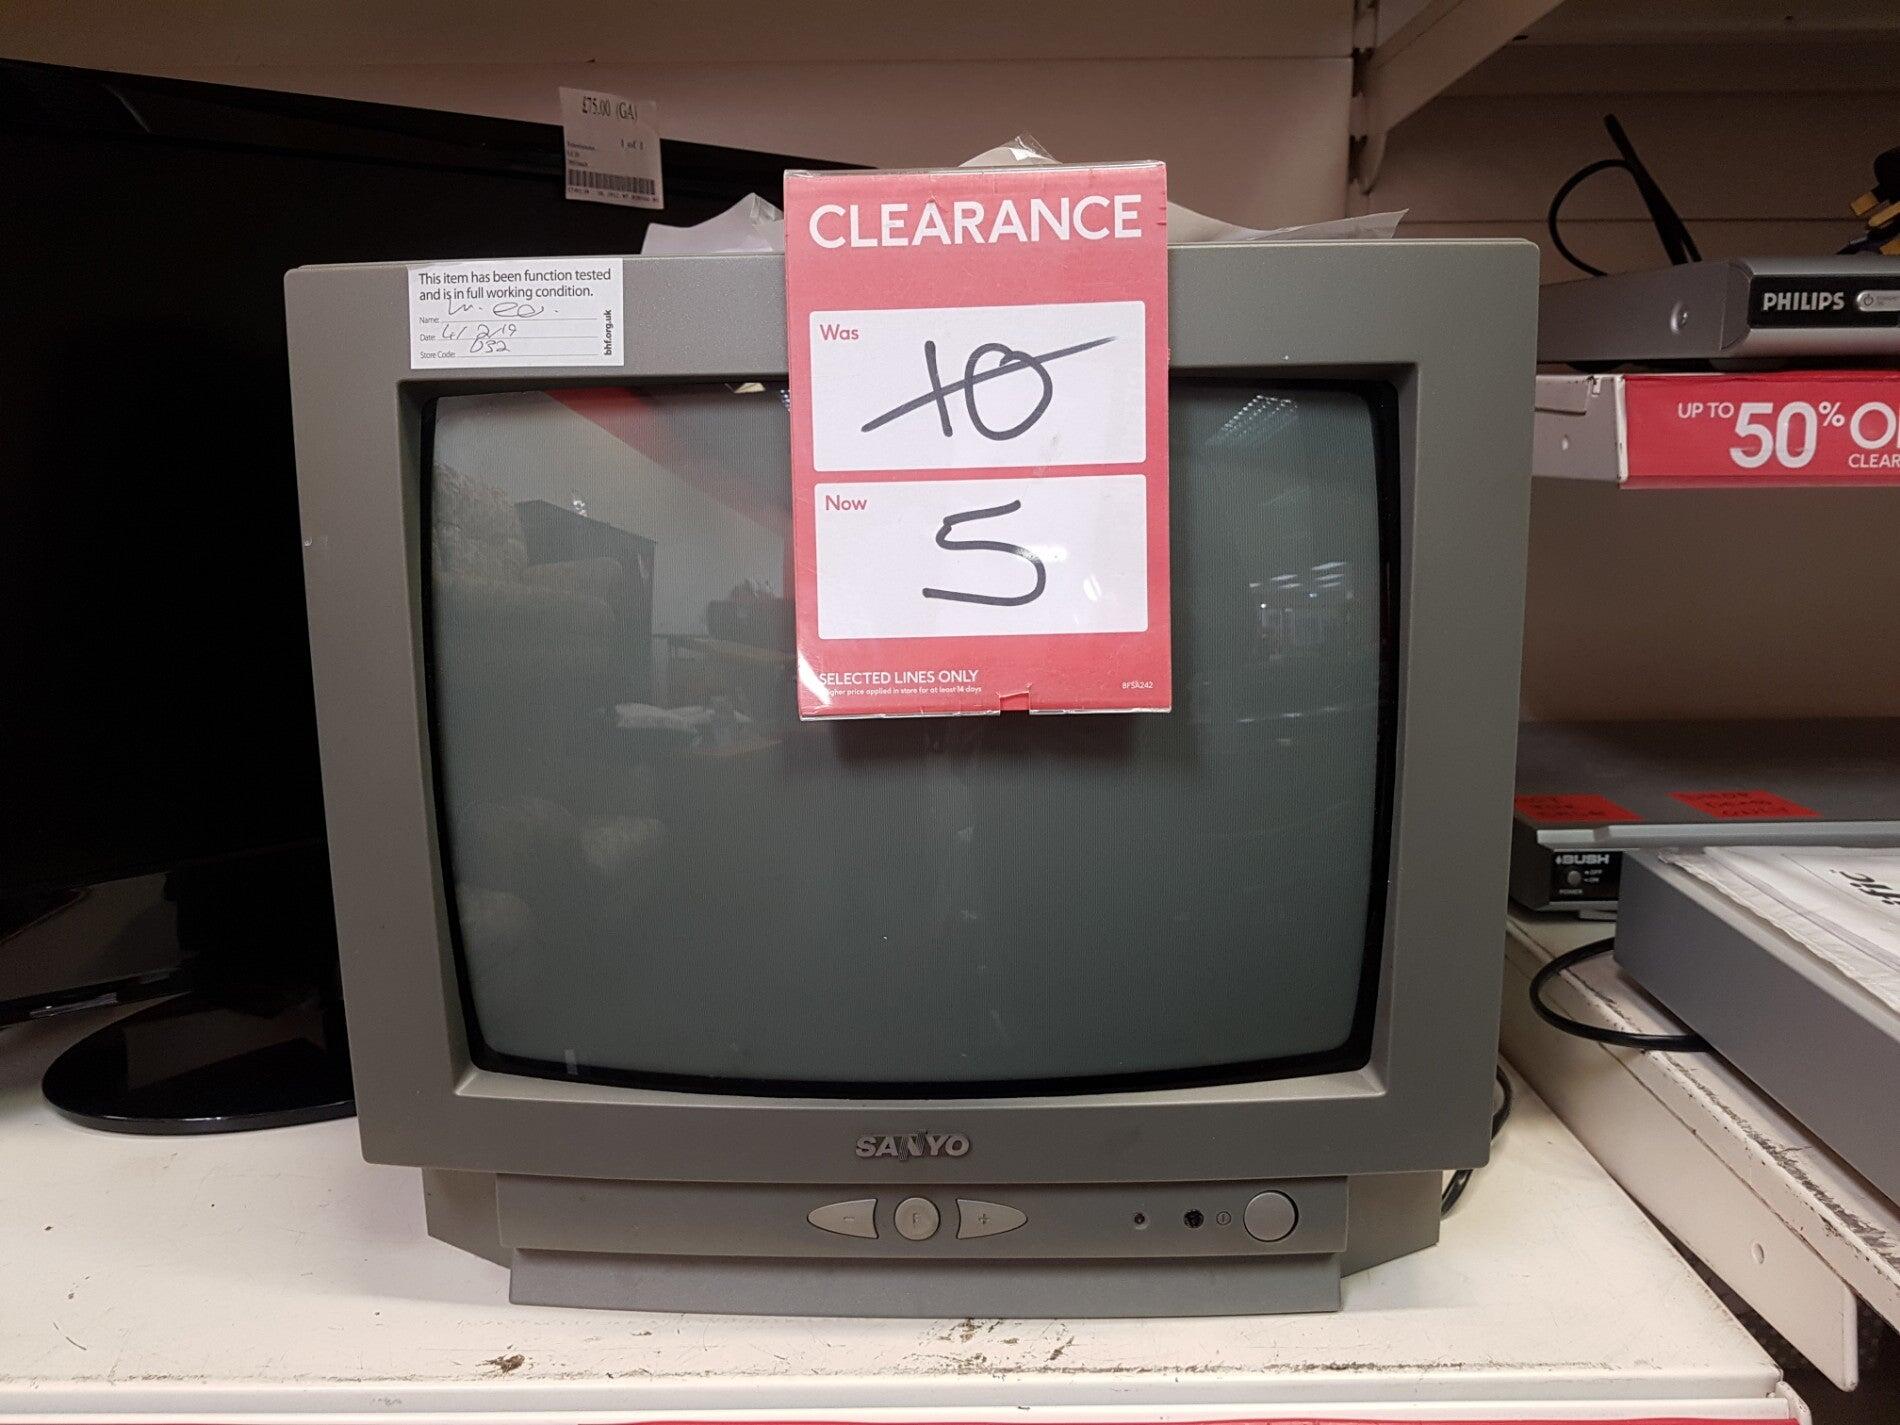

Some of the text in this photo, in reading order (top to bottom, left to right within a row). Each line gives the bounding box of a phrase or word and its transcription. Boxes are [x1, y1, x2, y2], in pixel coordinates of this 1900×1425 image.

[808, 194, 1143, 249] CLEARANCE
[418, 268, 611, 284] This item has been function tested
[419, 285, 594, 300] and is in full working condition.
[1763, 292, 1845, 311] PHILIPS
[604, 309, 614, 356] bhf.org.uk
[819, 324, 859, 341] Was
[420, 351, 436, 359] Store
[1678, 402, 1704, 418] UP
[1707, 402, 1734, 419] TO
[1850, 401, 1900, 450] O
[825, 495, 867, 511] Now
[922, 499, 1046, 607] 5
[820, 670, 979, 685] SELECTED LINES ONLY
[866, 687, 891, 695] applied
[965, 686, 982, 694] days
[1562, 854, 1610, 865] BUSH
[855, 1132, 971, 1160] SANYO
